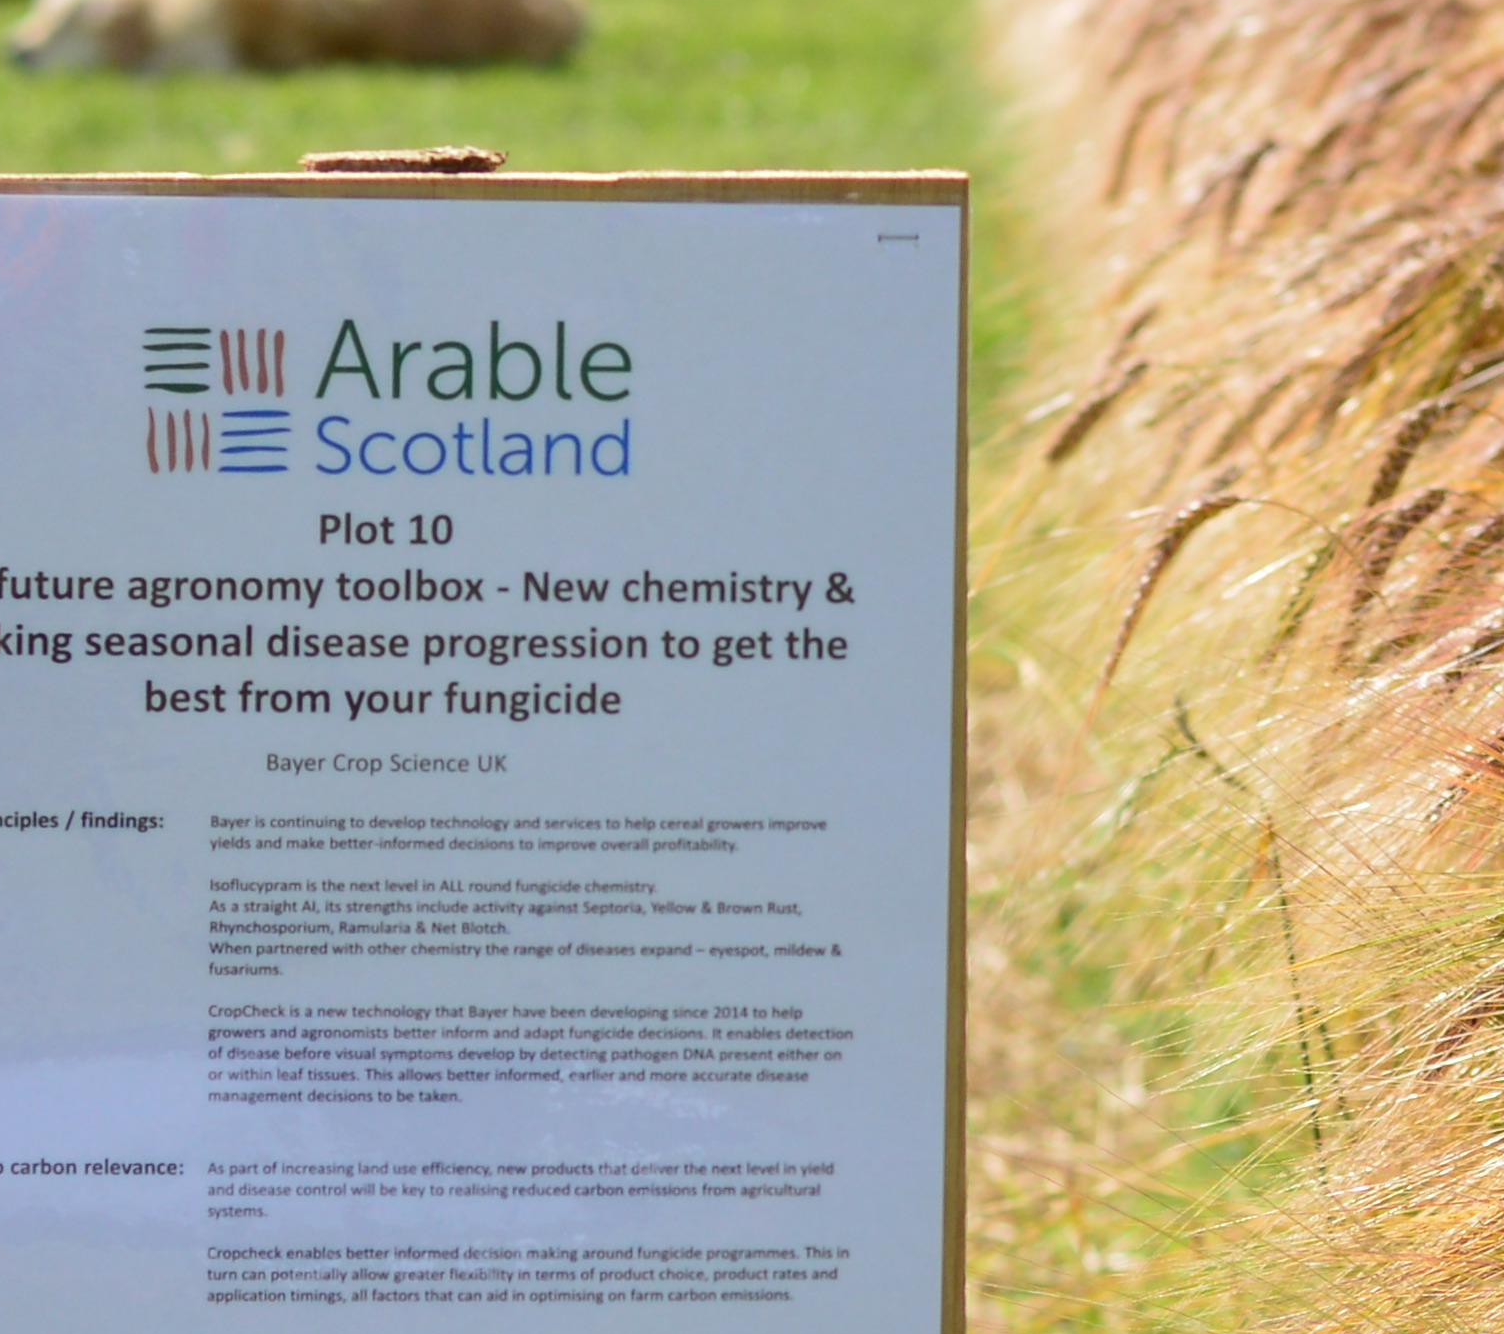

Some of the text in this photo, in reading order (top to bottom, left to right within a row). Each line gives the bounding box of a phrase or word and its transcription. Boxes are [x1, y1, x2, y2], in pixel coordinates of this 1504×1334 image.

[314, 318, 633, 402] Arable
[315, 415, 630, 477] Scotland
[319, 511, 454, 546] Plot 10
[127, 576, 325, 609] agronomy
[335, 568, 484, 602] toolbox
[523, 571, 610, 603] New
[622, 569, 813, 609] chemistry
[824, 571, 856, 605] &
[84, 623, 253, 658] seasonal
[266, 624, 410, 659] disease
[423, 626, 648, 665] progression
[660, 630, 701, 660] to
[712, 630, 773, 665] get
[784, 626, 848, 661] the
[145, 679, 622, 722] best from your fungicide
[266, 753, 507, 776] Bayer Crop Science UK
[64, 810, 76, 832] /
[80, 810, 164, 834] findings:
[210, 814, 828, 834] Bayer is continuing to develop technology and services to help cereal growers improve
[209, 877, 303, 895] Isoflucypram
[306, 879, 318, 893] is
[321, 878, 346, 893] the
[349, 880, 381, 893] next
[384, 879, 419, 893] level
[422, 880, 436, 892] in
[439, 879, 465, 893] ALL
[468, 879, 512, 893] round
[515, 879, 582, 897] fungicide
[209, 920, 335, 937] Rhynchosporium,
[338, 920, 412, 935] Ramularia
[414, 920, 427, 935] &
[431, 921, 457, 935] Net
[207, 1090, 303, 1106] management
[306, 1088, 374, 1103] decisions
[377, 1090, 393, 1103] to
[396, 1089, 415, 1103] be
[10, 1157, 77, 1176] carbon
[84, 1157, 184, 1176] relevance:
[206, 1288, 287, 1305] application
[289, 1289, 347, 1306] timings,
[350, 1288, 369, 1303] all
[371, 1287, 421, 1303] factors
[424, 1289, 454, 1302] that
[456, 1291, 483, 1303] can
[486, 1288, 509, 1303] aid
[511, 1289, 526, 1302] in
[528, 1289, 604, 1305] optimising
[607, 1291, 627, 1302] on
[630, 1288, 664, 1302] farm
[667, 1288, 718, 1302] carbon
